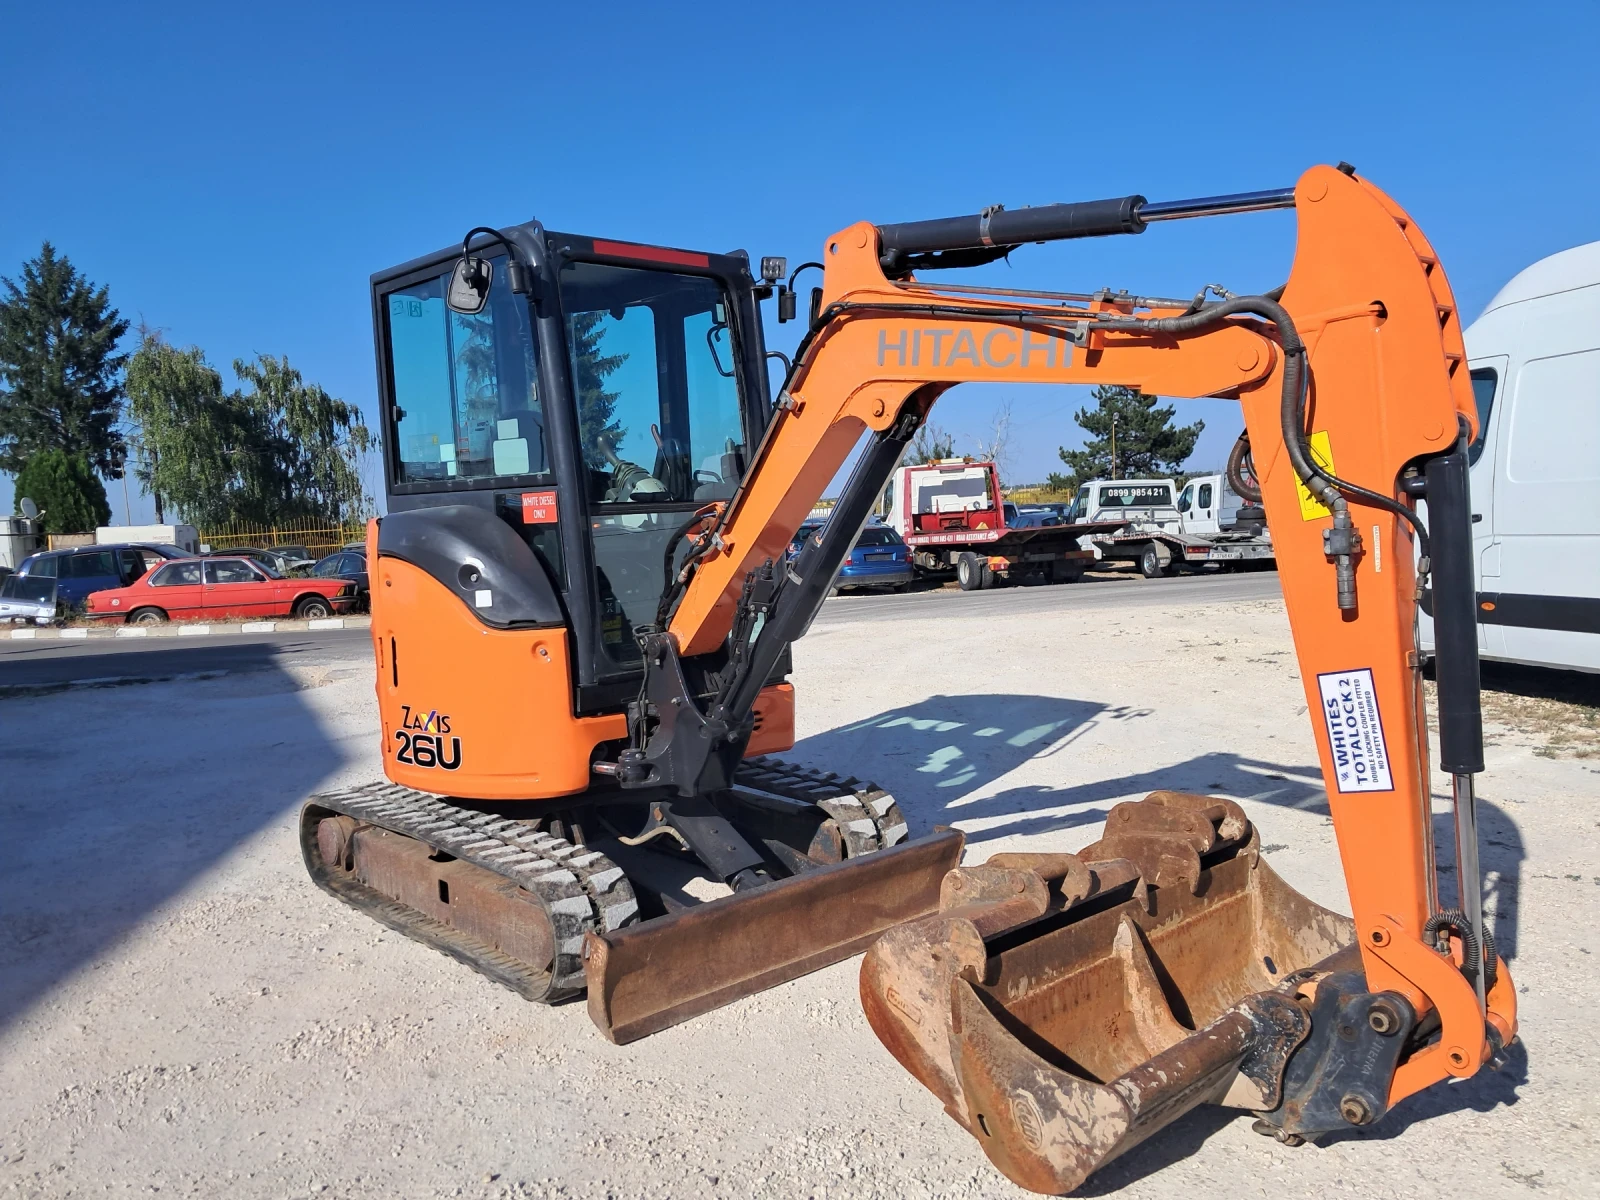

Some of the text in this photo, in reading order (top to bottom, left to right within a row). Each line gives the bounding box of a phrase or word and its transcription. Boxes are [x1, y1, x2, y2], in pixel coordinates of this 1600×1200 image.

[877, 328, 1074, 368] HITACHI
[523, 495, 556, 507] WHITE DIESEL
[1108, 488, 1129, 497] 0899
[533, 508, 546, 519] ONLY
[1365, 690, 1376, 721] REQUIRED
[1327, 697, 1349, 767] WHITES
[1339, 678, 1368, 785] TOTALOCK 2
[1354, 678, 1379, 783] DOUBLE LOCKING COUPLER FITTED
[395, 730, 462, 771] 26U
[1374, 736, 1383, 759] SAFETY
[1378, 762, 1385, 770] NO
